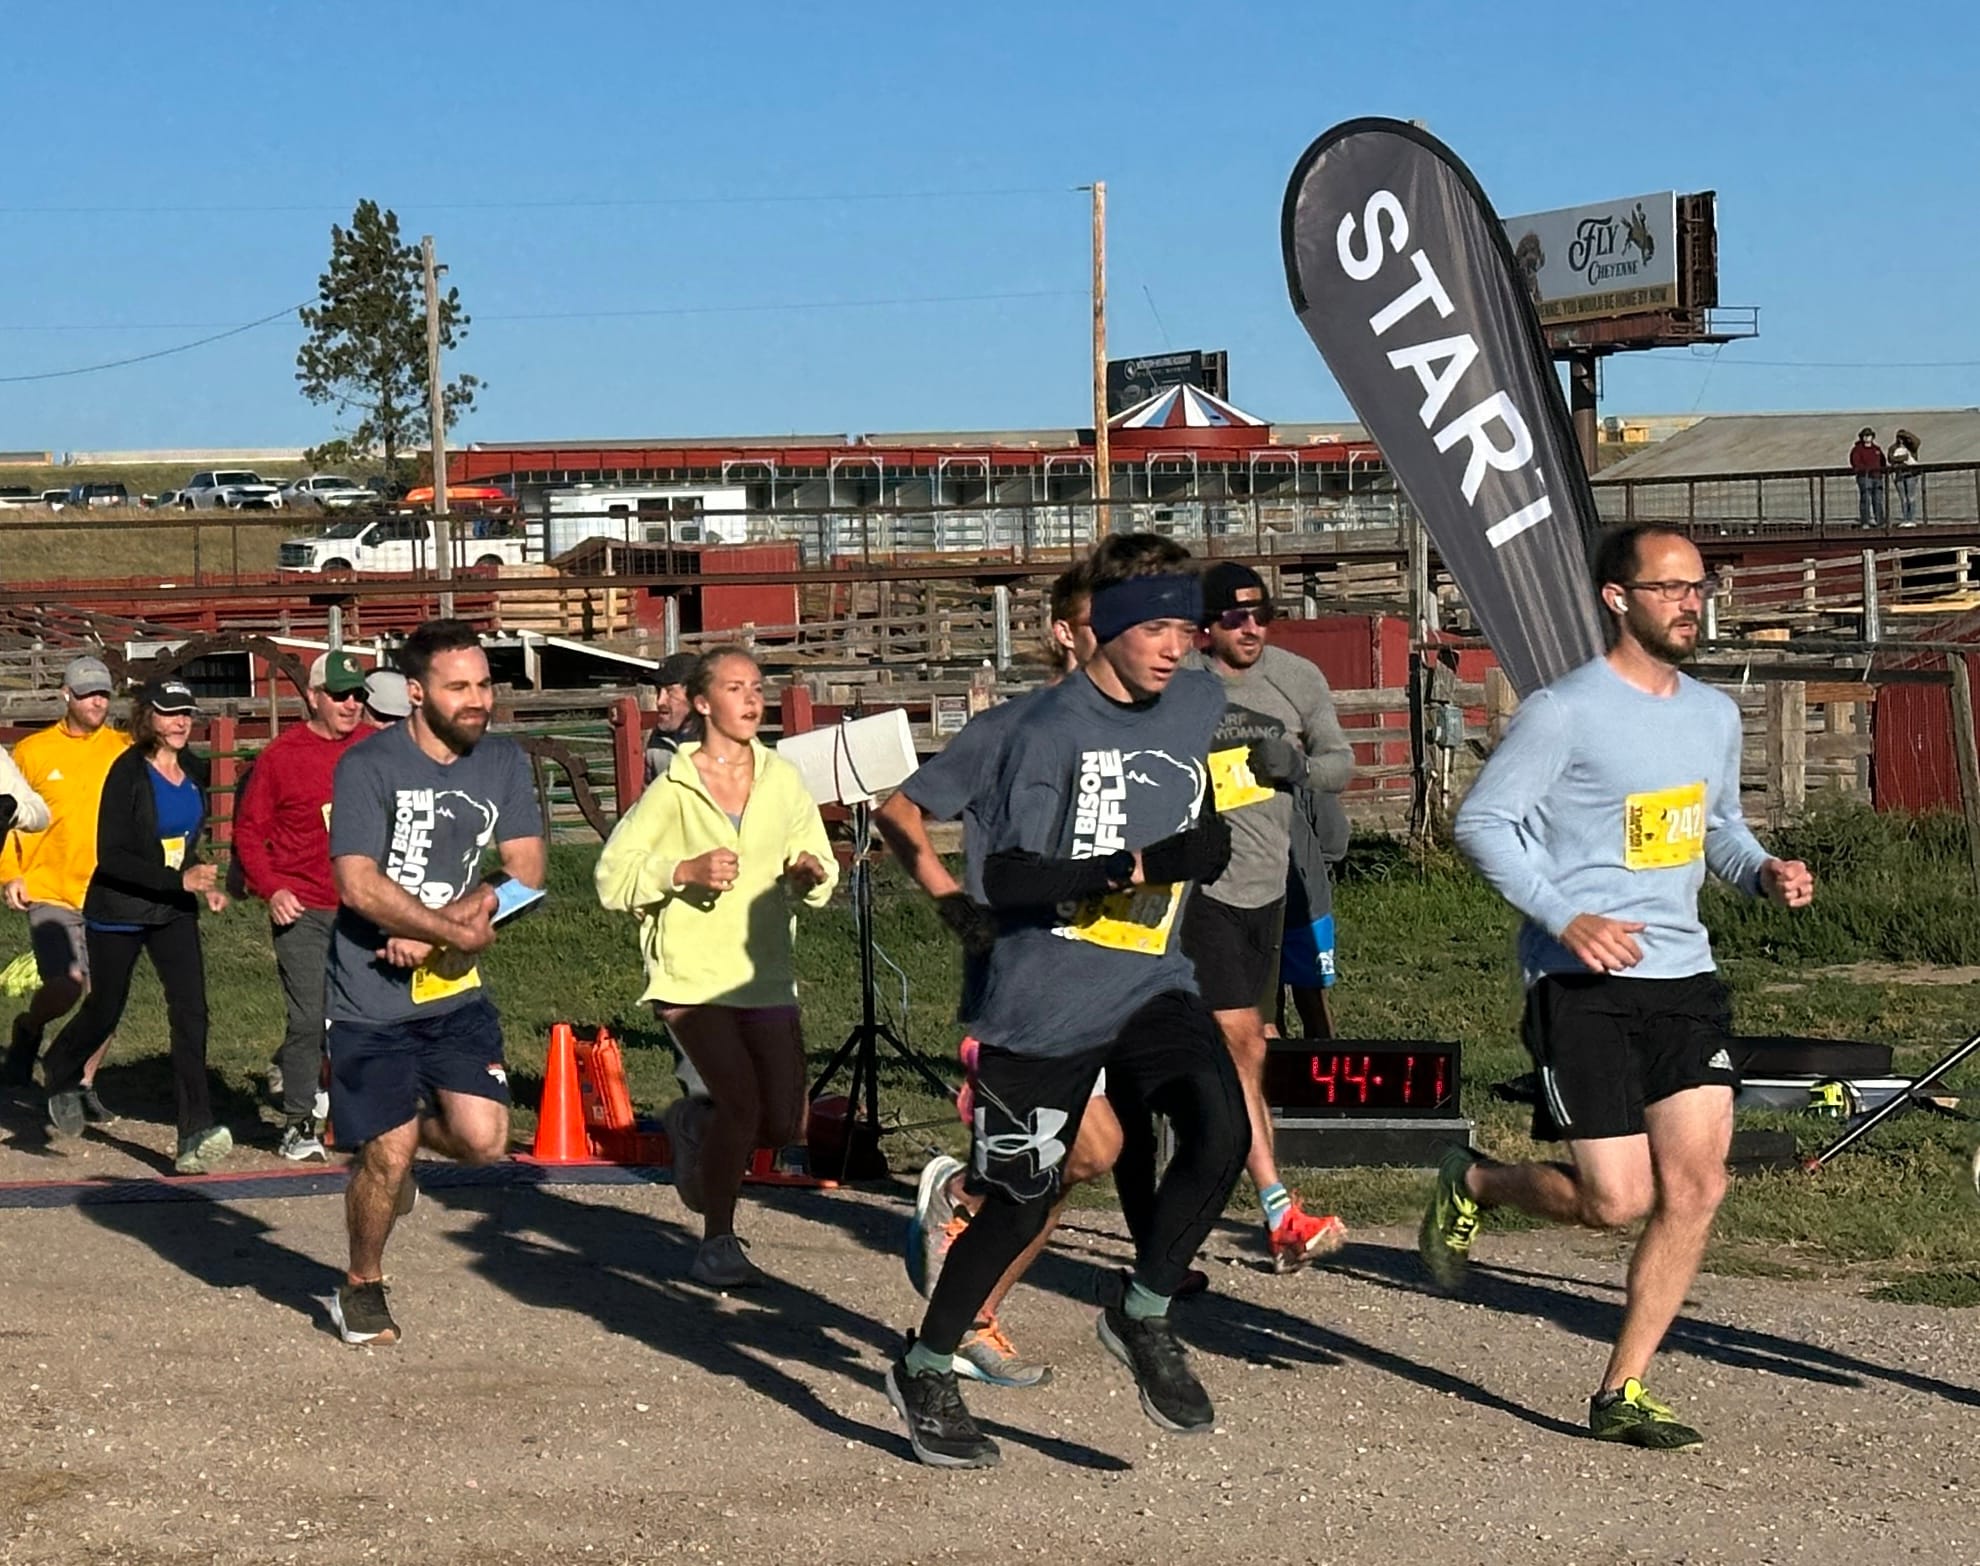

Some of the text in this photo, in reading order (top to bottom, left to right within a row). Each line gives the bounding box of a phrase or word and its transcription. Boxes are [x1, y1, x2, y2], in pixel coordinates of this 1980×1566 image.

[1568, 215, 1620, 272] FLY
[1587, 259, 1640, 286] CHEYENNE
[1336, 190, 1552, 549] START
[392, 790, 414, 854] BISON
[1075, 751, 1101, 834] BISON
[1093, 748, 1128, 857] FFLE
[399, 788, 435, 895] UFFLE
